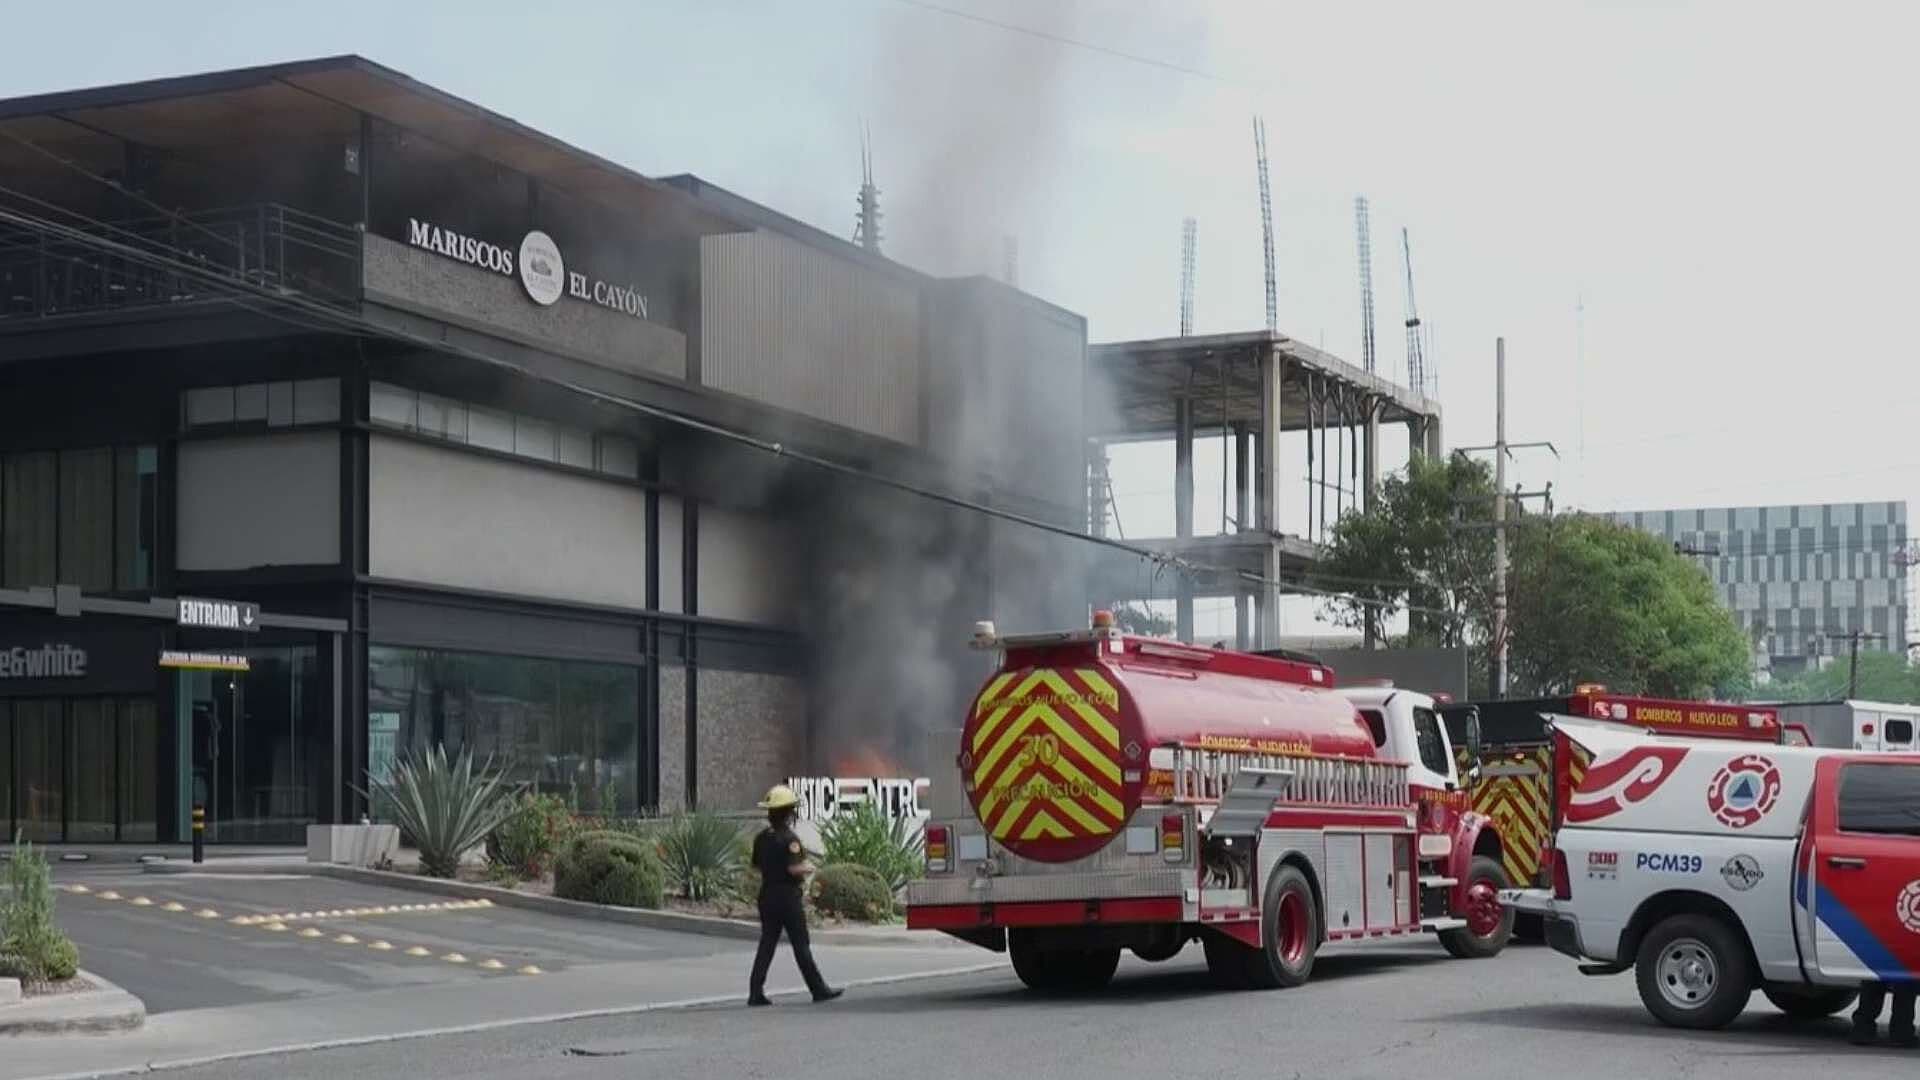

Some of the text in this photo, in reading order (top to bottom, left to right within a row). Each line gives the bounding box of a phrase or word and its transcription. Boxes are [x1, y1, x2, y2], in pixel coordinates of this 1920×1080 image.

[409, 217, 513, 275] MARISCOS
[570, 272, 592, 300] EL
[594, 281, 649, 320] CAYÓN
[180, 600, 240, 628] ENTRADA
[1636, 707, 1682, 724] BOMBEROS
[1689, 711, 1715, 725] NUEVO
[1017, 733, 1060, 768] 30
[1636, 853, 1703, 873] PCM39
